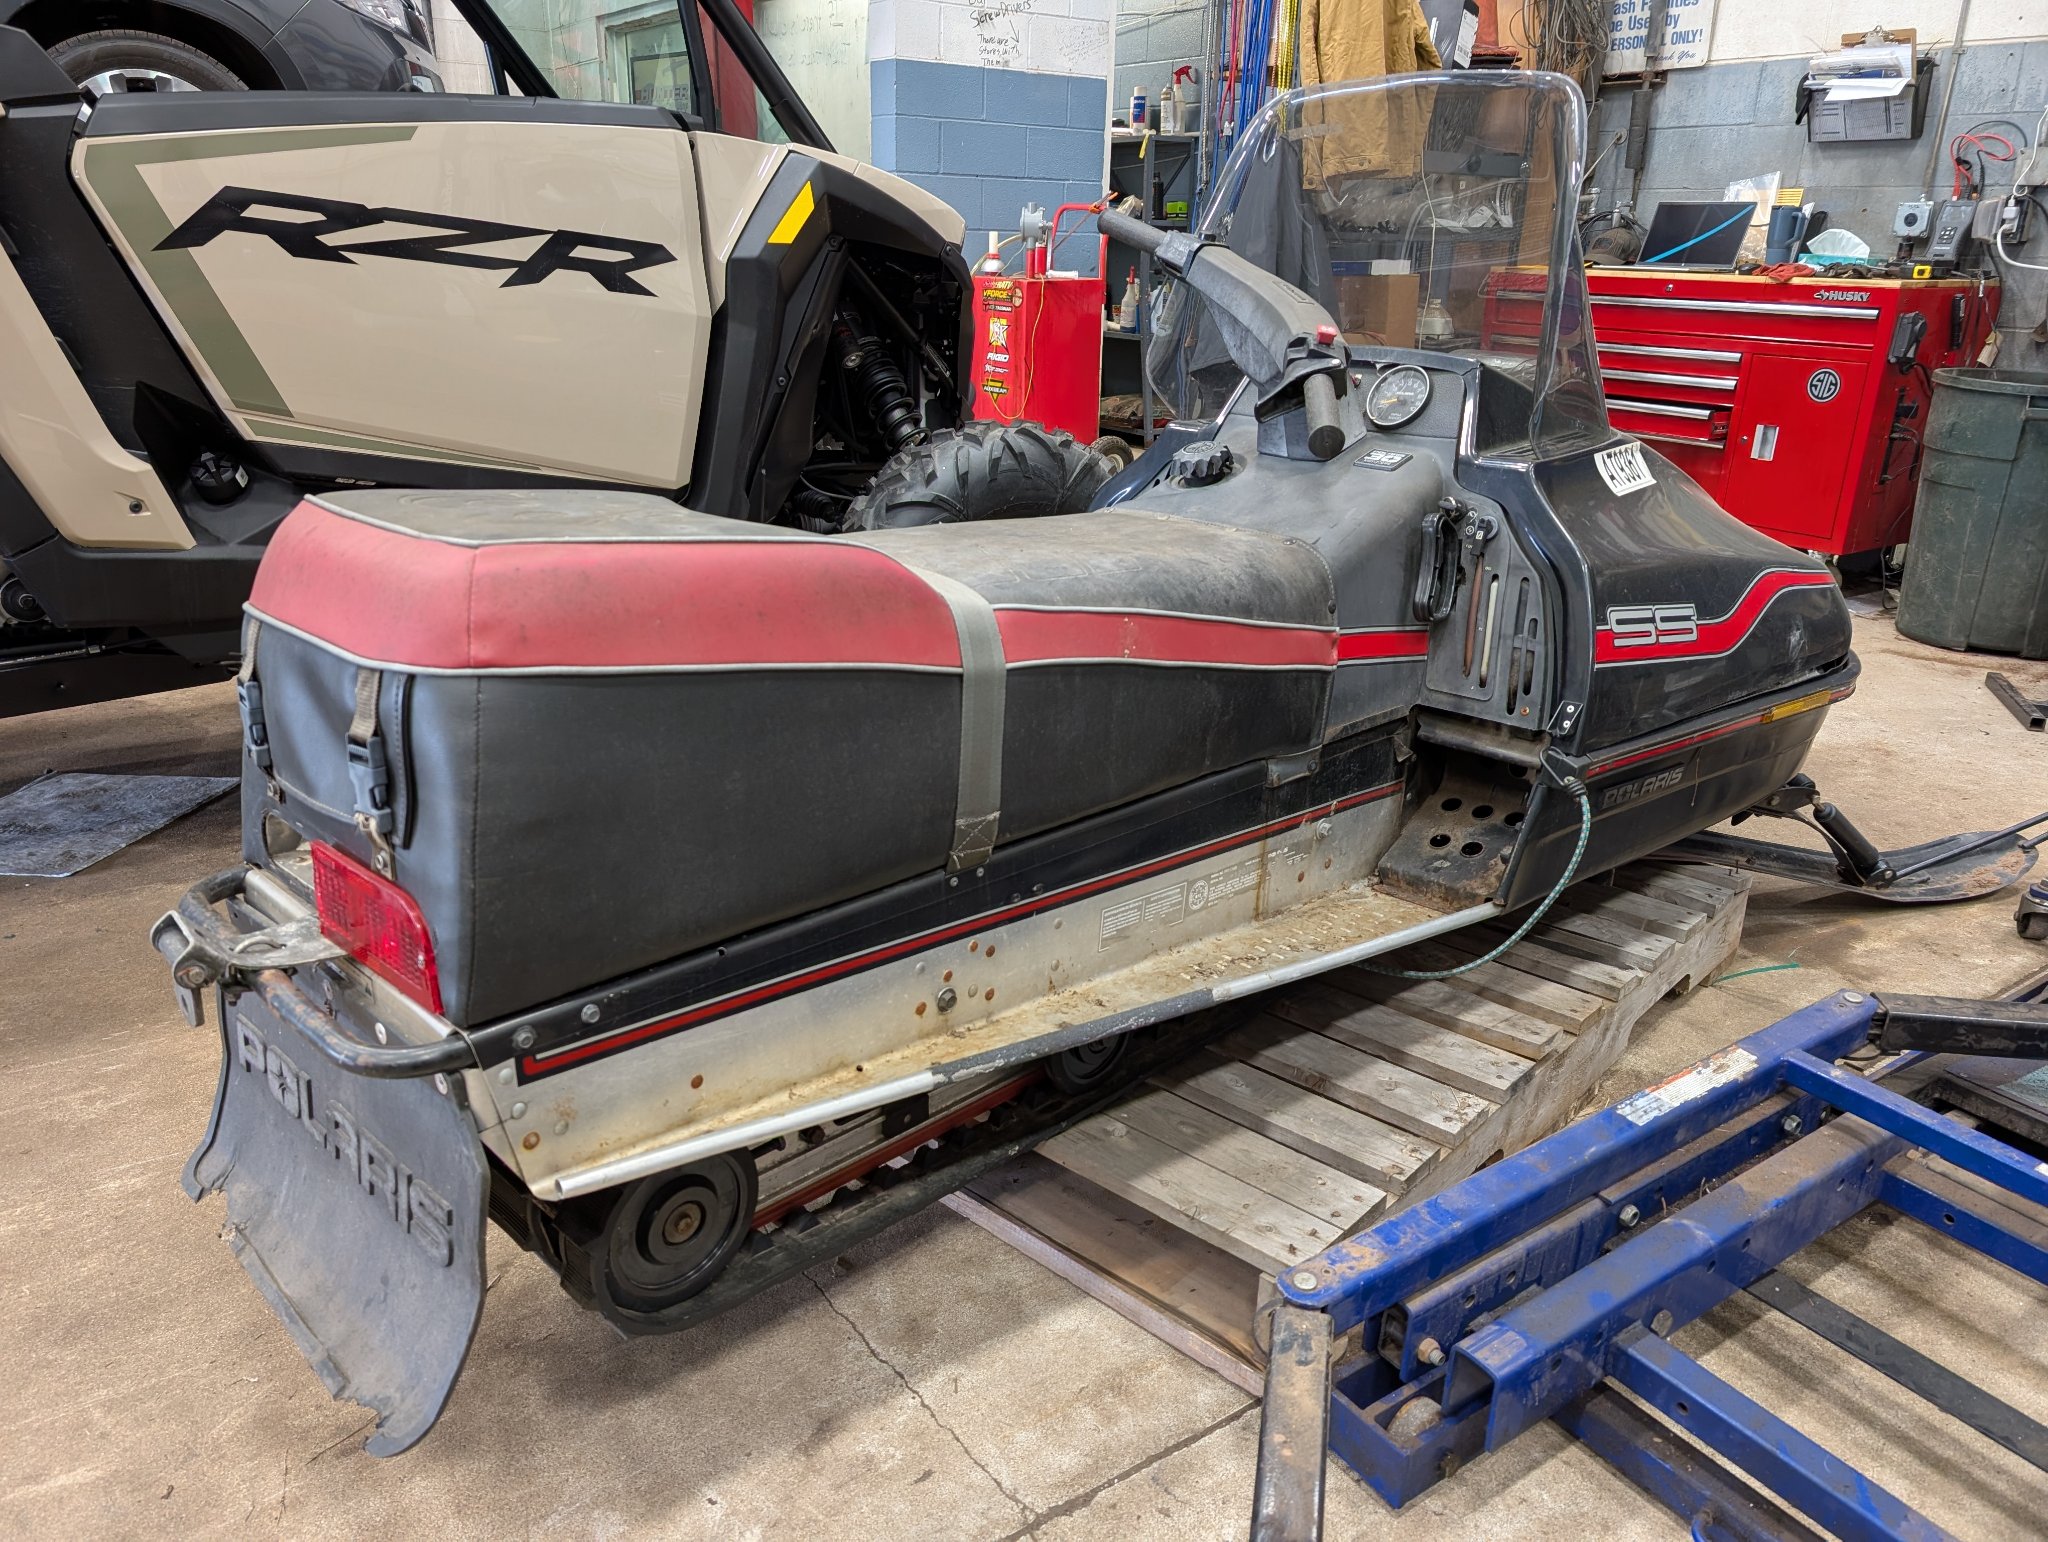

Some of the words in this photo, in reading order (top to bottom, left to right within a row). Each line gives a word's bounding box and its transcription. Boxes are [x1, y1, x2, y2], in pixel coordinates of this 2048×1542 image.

[1665, 11, 1680, 29] by
[1671, 29, 1703, 46] ONLY!
[1677, 50, 1696, 63] You
[151, 186, 678, 298] RZR
[1828, 290, 1871, 302] HUSKY
[1811, 372, 1837, 399] SIG
[1607, 603, 1698, 648] SS
[1601, 766, 1686, 811] POLARIS
[236, 1012, 454, 1268] POLARIS
